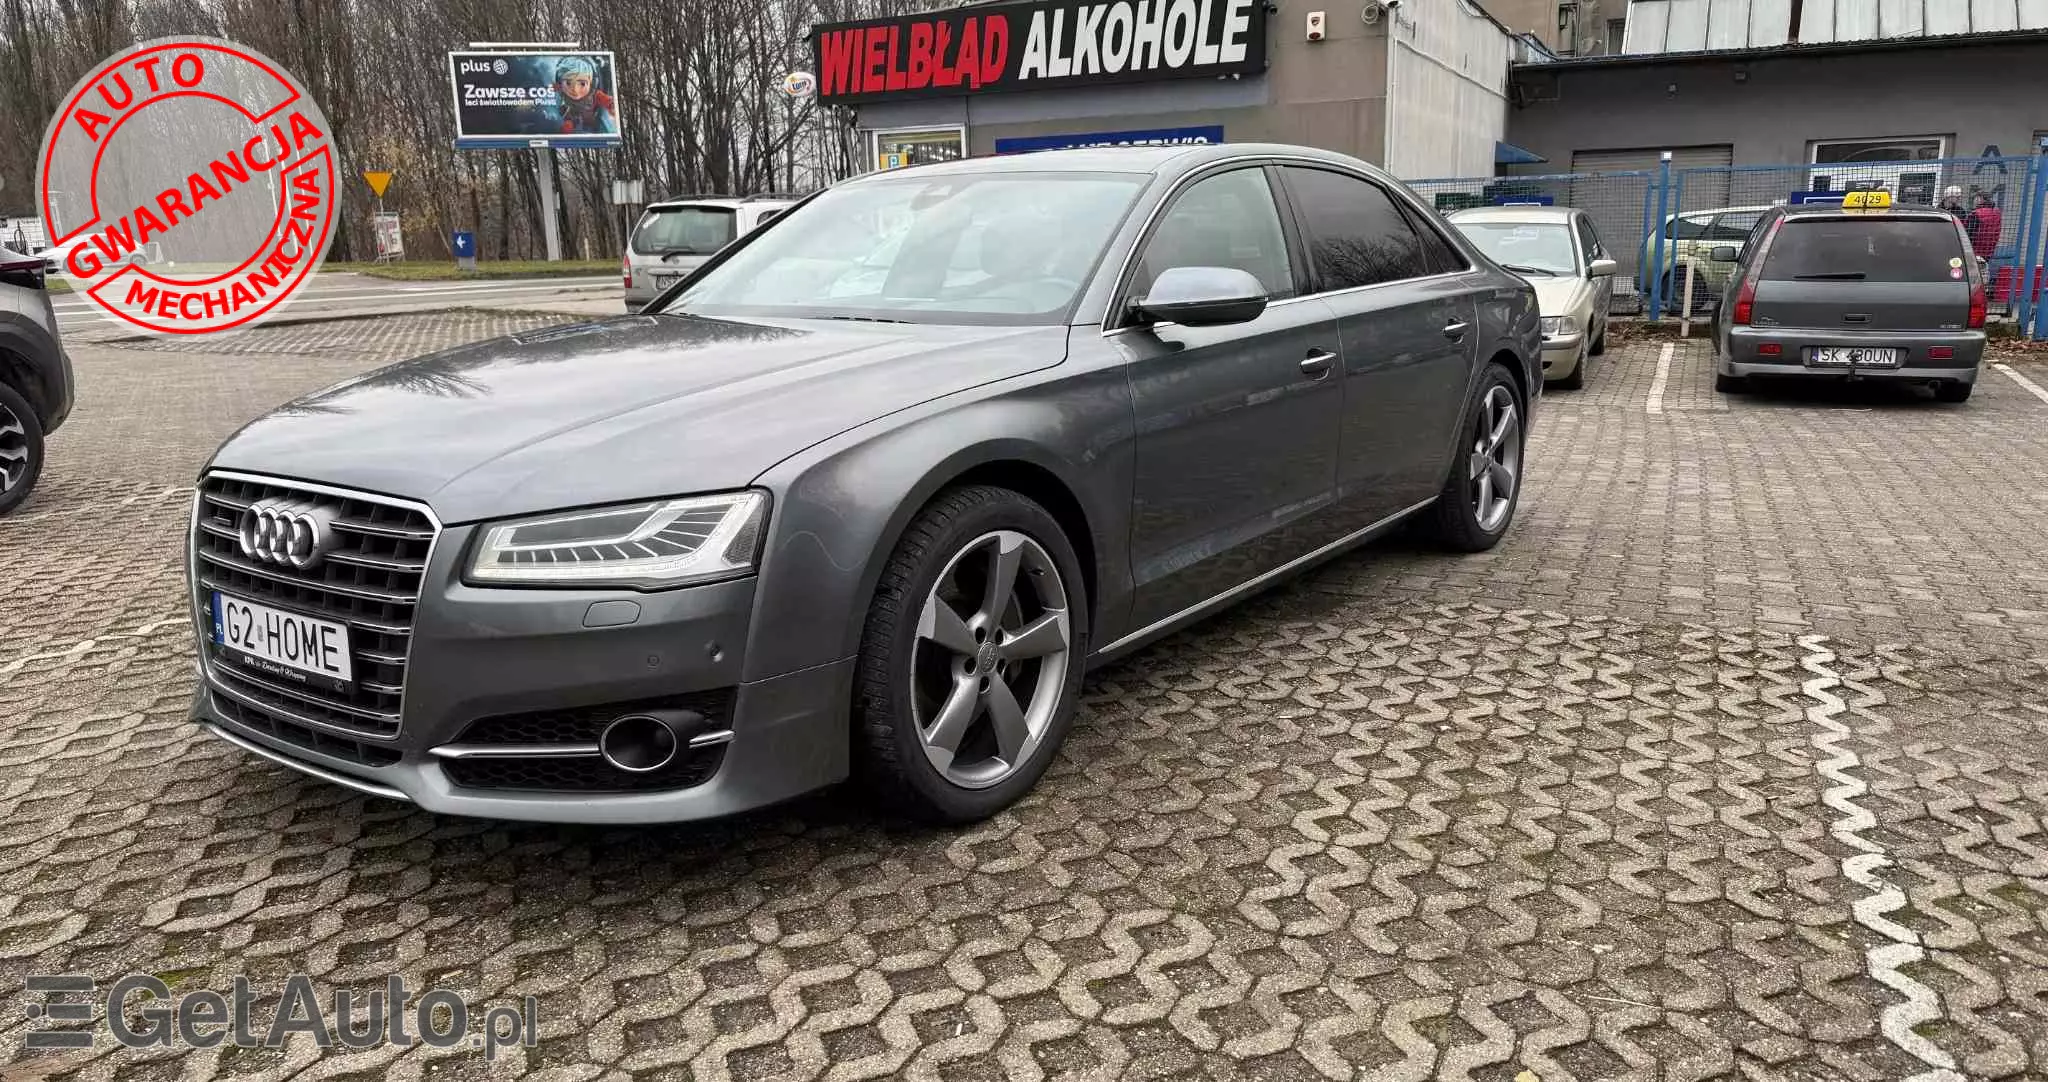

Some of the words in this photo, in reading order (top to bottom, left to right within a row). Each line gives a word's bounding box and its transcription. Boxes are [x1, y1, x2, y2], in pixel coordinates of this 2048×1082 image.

[820, 14, 1009, 95] WIELBŁAD
[1017, 0, 1251, 80] ALKOHOLE
[460, 59, 491, 75] plus
[463, 84, 526, 98] Zawsze
[528, 84, 556, 98] coś
[1820, 347, 1841, 361] SK
[227, 602, 255, 649] G2
[266, 612, 339, 672] HOME
